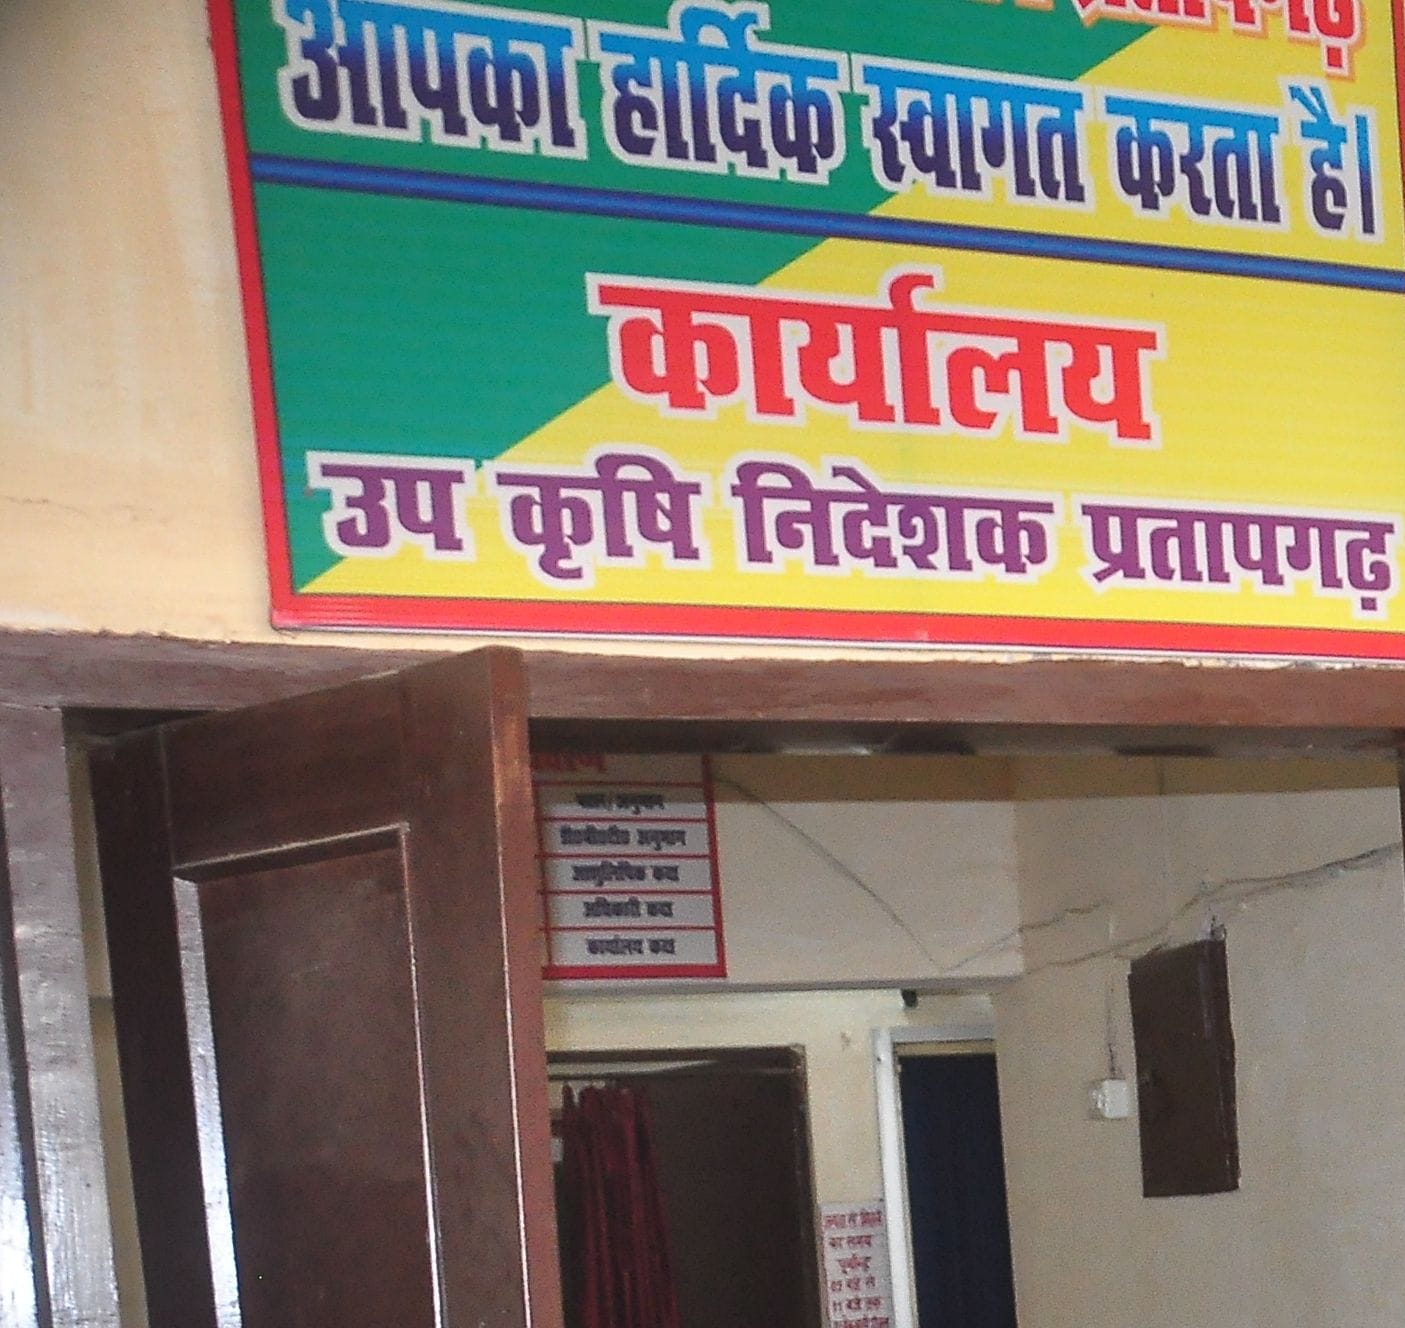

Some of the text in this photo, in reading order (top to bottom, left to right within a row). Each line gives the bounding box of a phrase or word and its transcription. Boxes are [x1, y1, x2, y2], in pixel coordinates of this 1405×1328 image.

[287, 2, 1376, 236] आपका हार्दिक स्वागत करता है।
[592, 274, 1157, 441] कार्यालय
[322, 453, 1394, 615] उप कृषि निदेशक प्रतापगढ़
